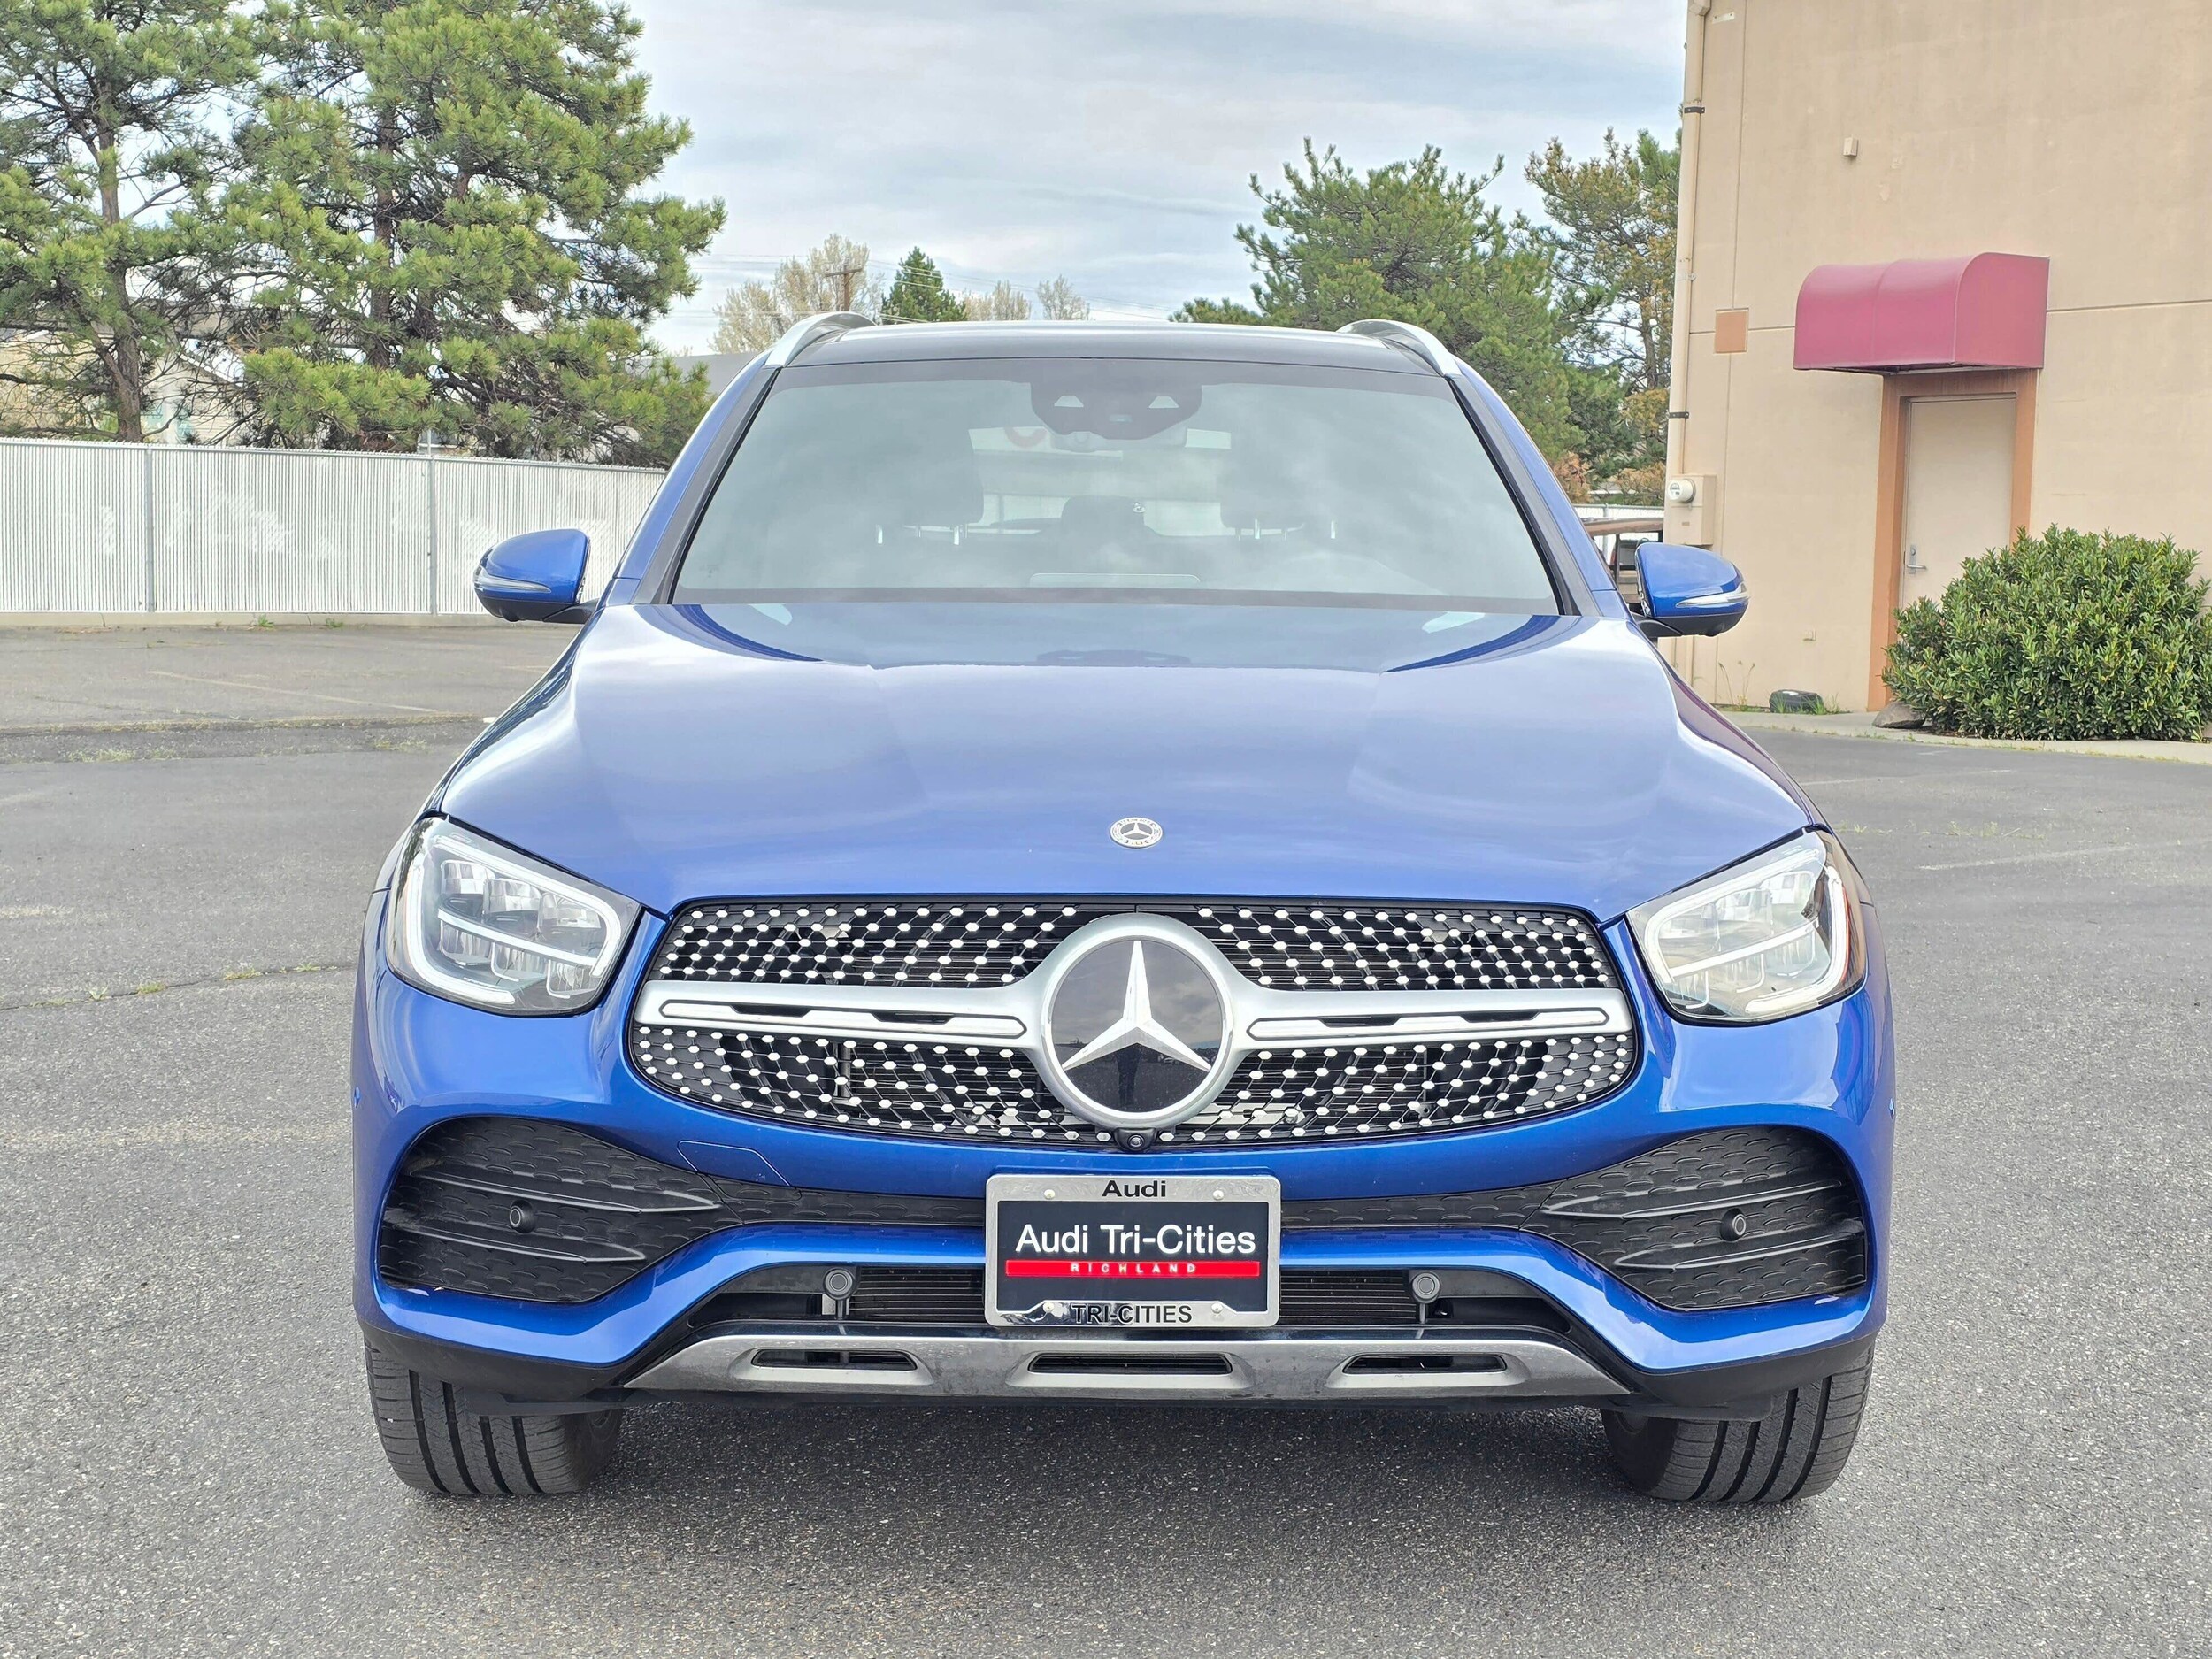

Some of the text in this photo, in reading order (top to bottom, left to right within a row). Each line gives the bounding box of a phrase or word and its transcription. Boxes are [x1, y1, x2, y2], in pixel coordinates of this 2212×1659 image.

[1102, 1180, 1166, 1197] Audi
[1015, 1224, 1256, 1254] Audi Tri-Cities
[1071, 1263, 1196, 1273] RICHLAND
[1072, 1305, 1192, 1324] TRI-CITIES
